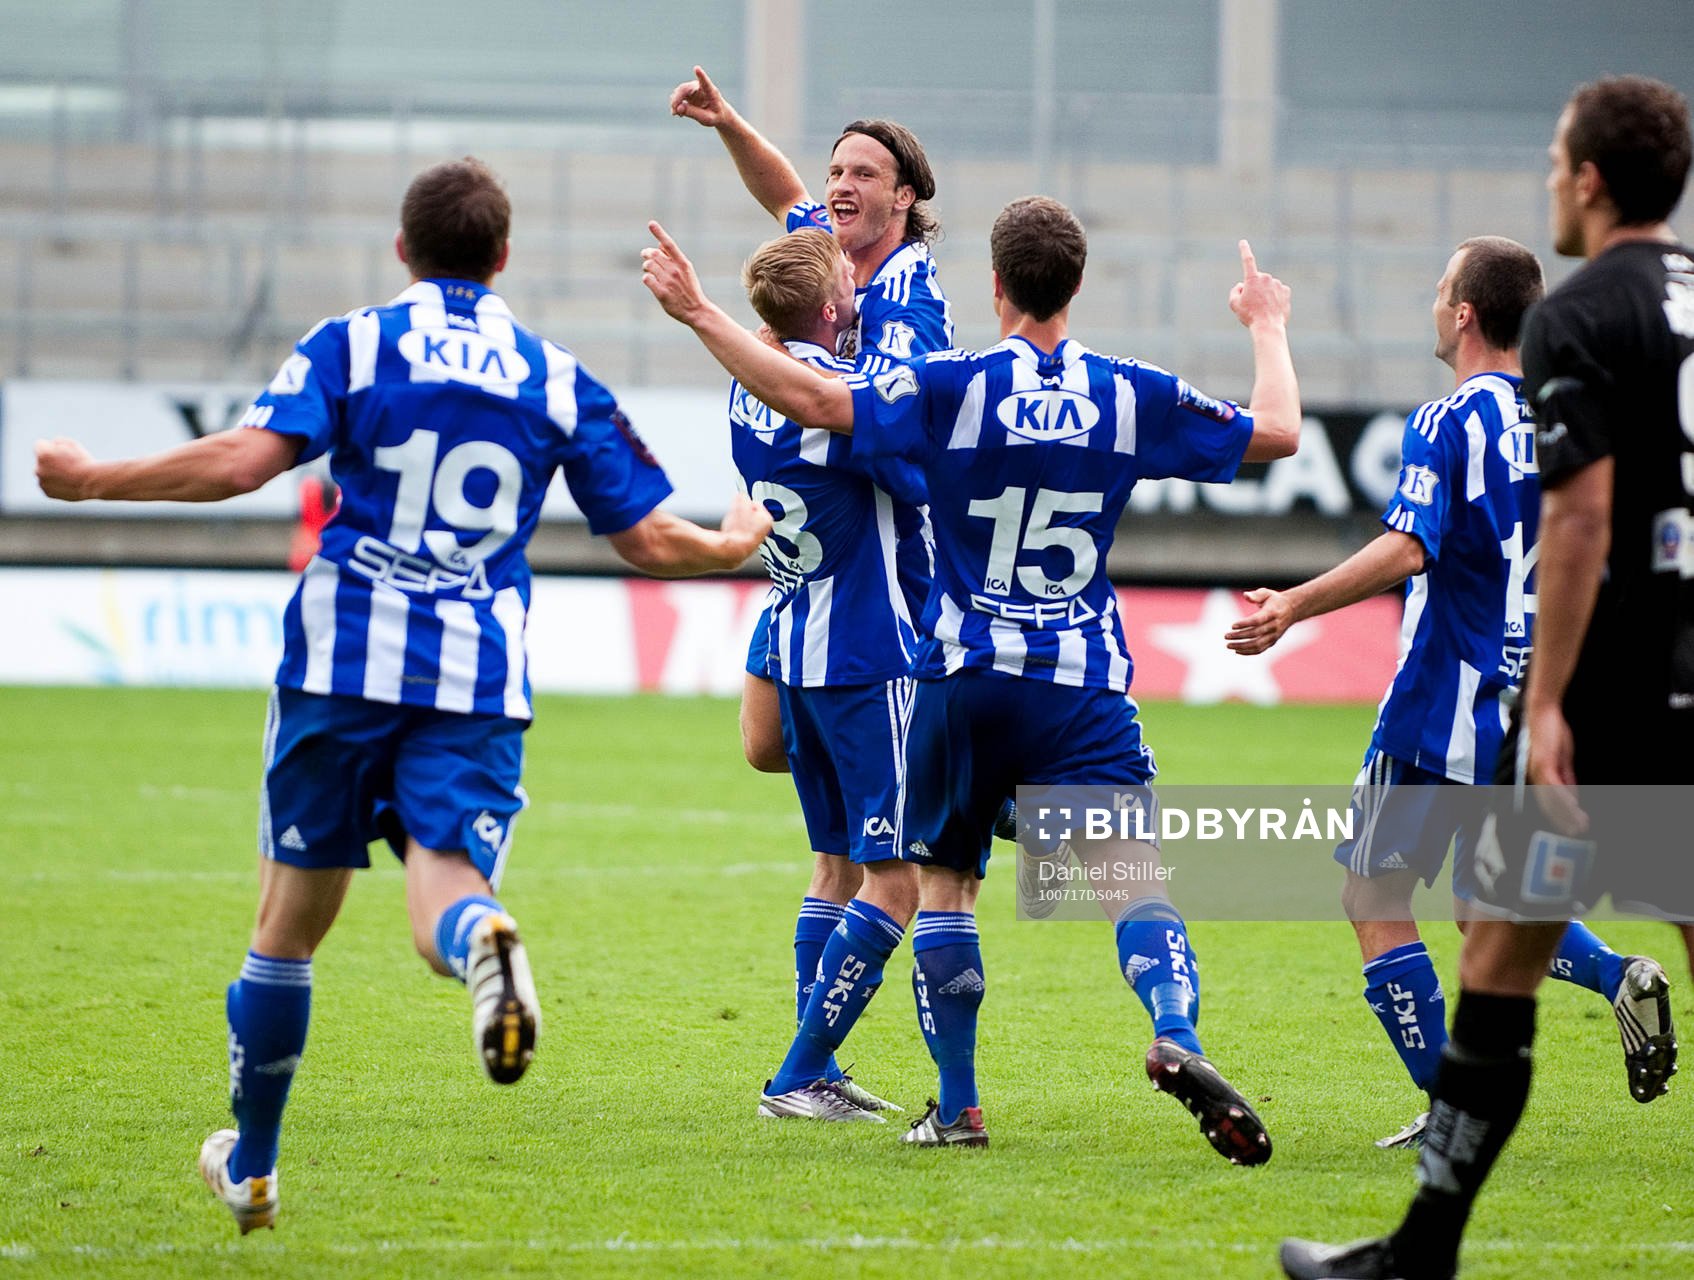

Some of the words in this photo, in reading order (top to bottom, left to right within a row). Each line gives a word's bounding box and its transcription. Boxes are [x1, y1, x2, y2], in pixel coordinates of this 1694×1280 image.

[424, 336, 507, 378] KIA
[1016, 397, 1083, 431] KIA
[374, 429, 523, 571] 19
[968, 486, 1104, 599] 15
[986, 578, 1008, 592] ICA
[1045, 584, 1067, 596] ICA
[1505, 621, 1523, 633] ICA
[1498, 646, 1534, 679] SE
[862, 817, 896, 837] ICA
[823, 954, 867, 1028] SKF
[1387, 982, 1426, 1050] SKF
